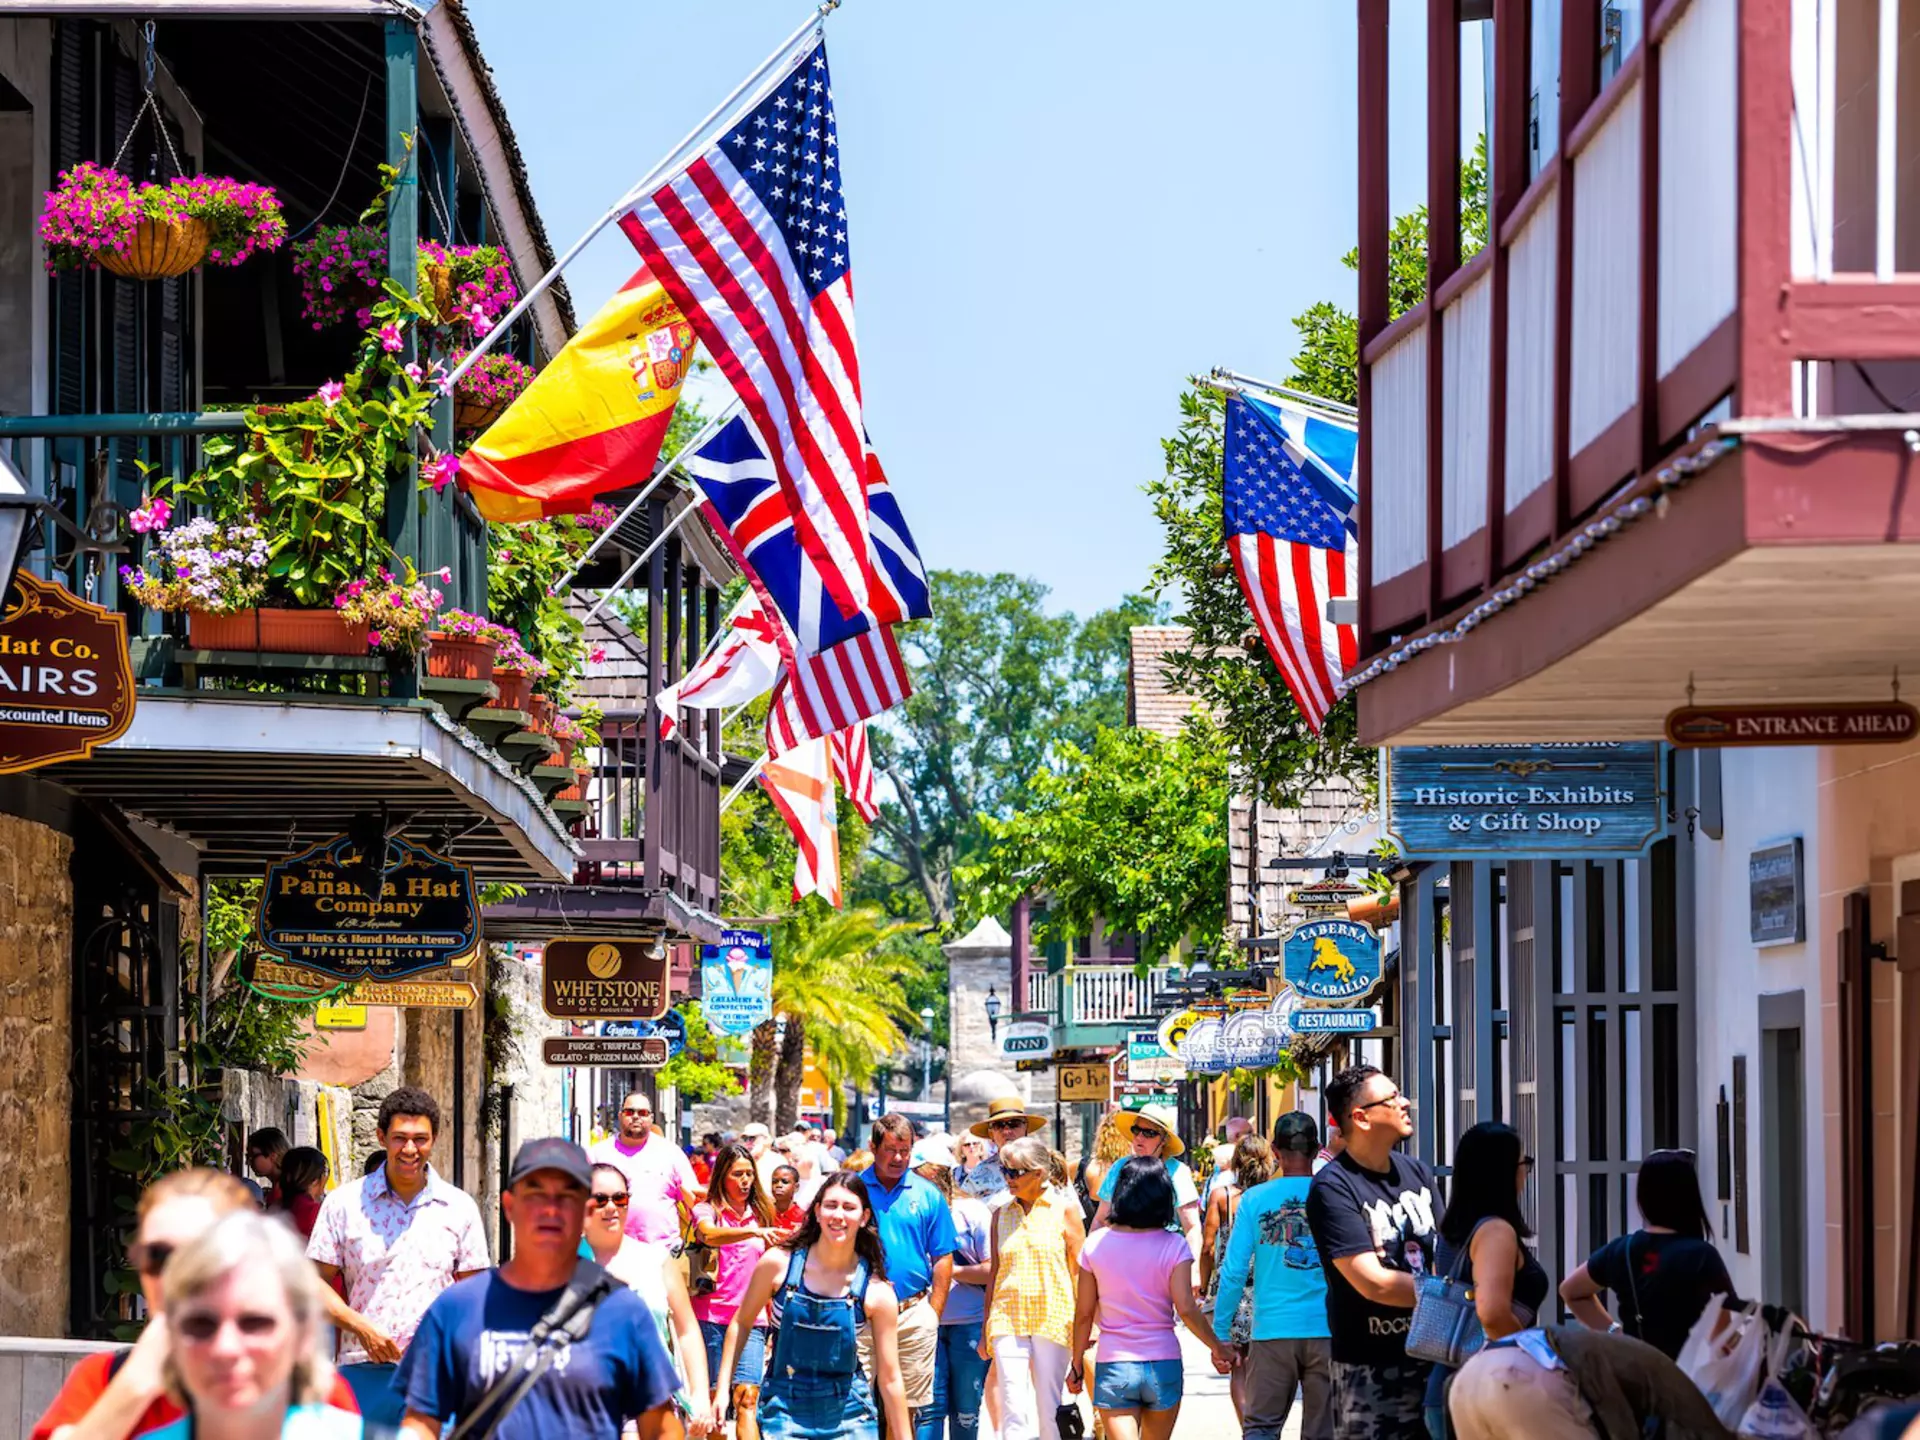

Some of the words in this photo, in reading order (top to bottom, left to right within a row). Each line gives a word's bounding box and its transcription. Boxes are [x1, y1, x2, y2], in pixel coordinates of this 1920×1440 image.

[50, 638, 99, 659] Co.
[67, 711, 109, 727] Items
[1736, 716, 1839, 735] ENTRANCE
[1844, 714, 1911, 733] AHEAD
[1413, 786, 1519, 805] Historic
[1527, 785, 1635, 804] Exhibits
[1449, 814, 1470, 831] &
[1480, 813, 1530, 831] Gift
[1537, 813, 1601, 836] Shop
[307, 869, 334, 879] The
[279, 875, 397, 896] Panaa
[406, 877, 461, 897] Hat
[315, 896, 423, 918] Company
[279, 932, 304, 942] Fine
[307, 932, 334, 943] Hats
[337, 933, 347, 943] &
[351, 933, 382, 944] Hand
[386, 934, 418, 944] Made
[422, 934, 456, 945] Items
[1297, 922, 1366, 944] TABERNA
[552, 980, 660, 998] WHETSTONE
[1311, 975, 1370, 996] CABALLO
[557, 998, 660, 1008] CHOCOLATES
[1298, 1013, 1367, 1027] RESTAURANT
[650, 1025, 681, 1038] Moon
[568, 1042, 596, 1051] FUDGE
[602, 1042, 642, 1051] TRUFFLES
[1011, 1038, 1041, 1051] INN
[550, 1053, 583, 1062] GELATO
[589, 1053, 620, 1062] FROZEN
[621, 1053, 661, 1063] BANANAS
[1063, 1071, 1082, 1088] Go
